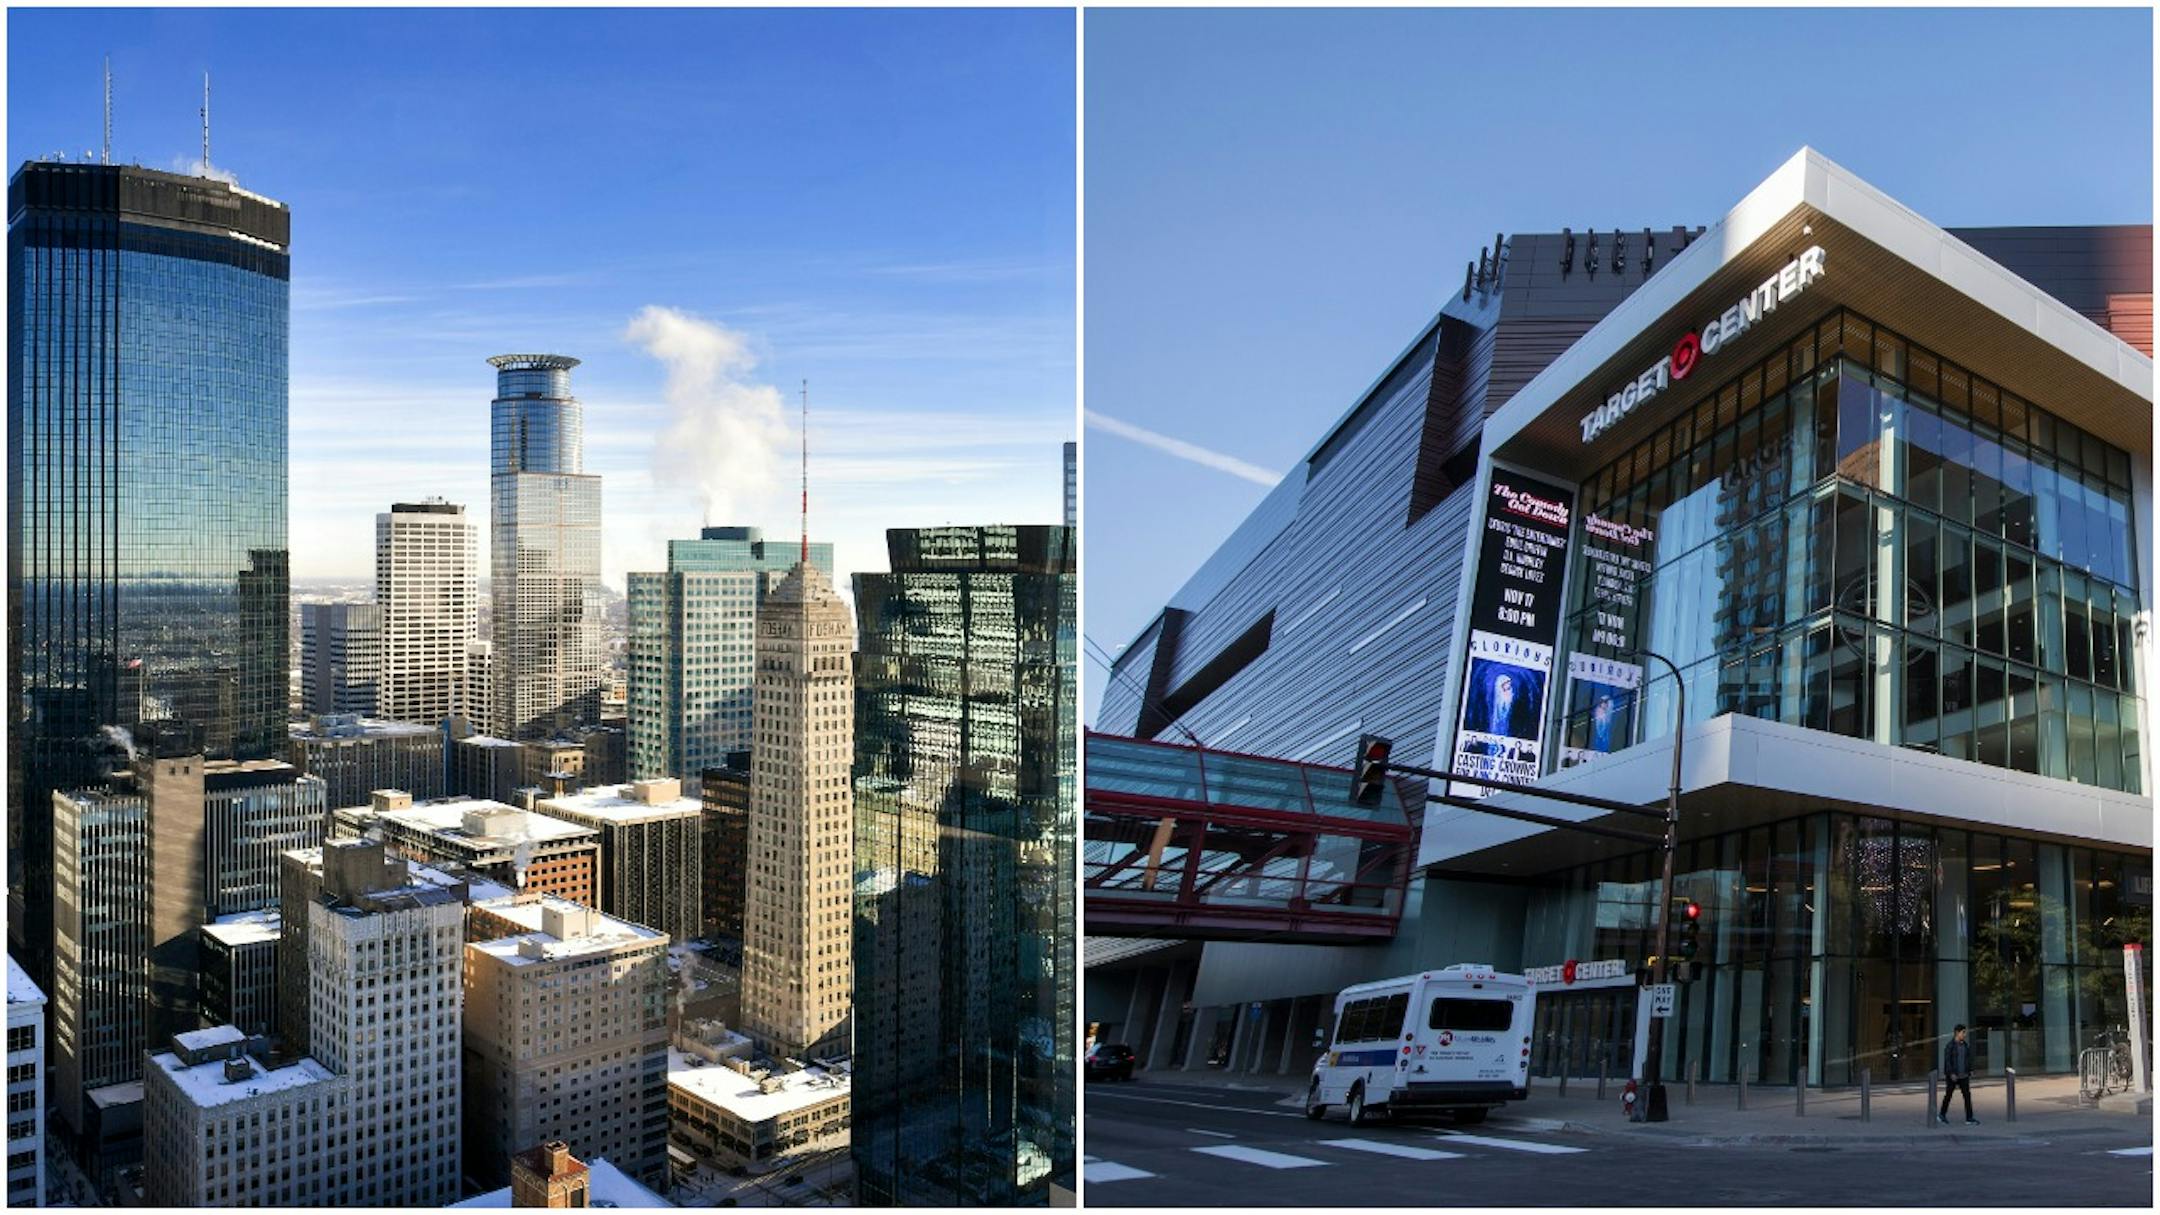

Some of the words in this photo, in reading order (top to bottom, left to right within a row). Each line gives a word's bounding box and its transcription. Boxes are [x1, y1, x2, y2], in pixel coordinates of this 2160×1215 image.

[1580, 355, 1672, 444] TARGET
[1701, 245, 1826, 355] CENTER
[1493, 483, 1518, 499] The
[1519, 492, 1569, 516] Comedy
[1504, 588, 1524, 605] NOV
[1498, 606, 1519, 624] 8:00
[1520, 612, 1535, 627] PM
[1457, 754, 1496, 770] CASTING
[1499, 760, 1537, 777] CROWNS
[1575, 959, 1627, 980] CENTER
